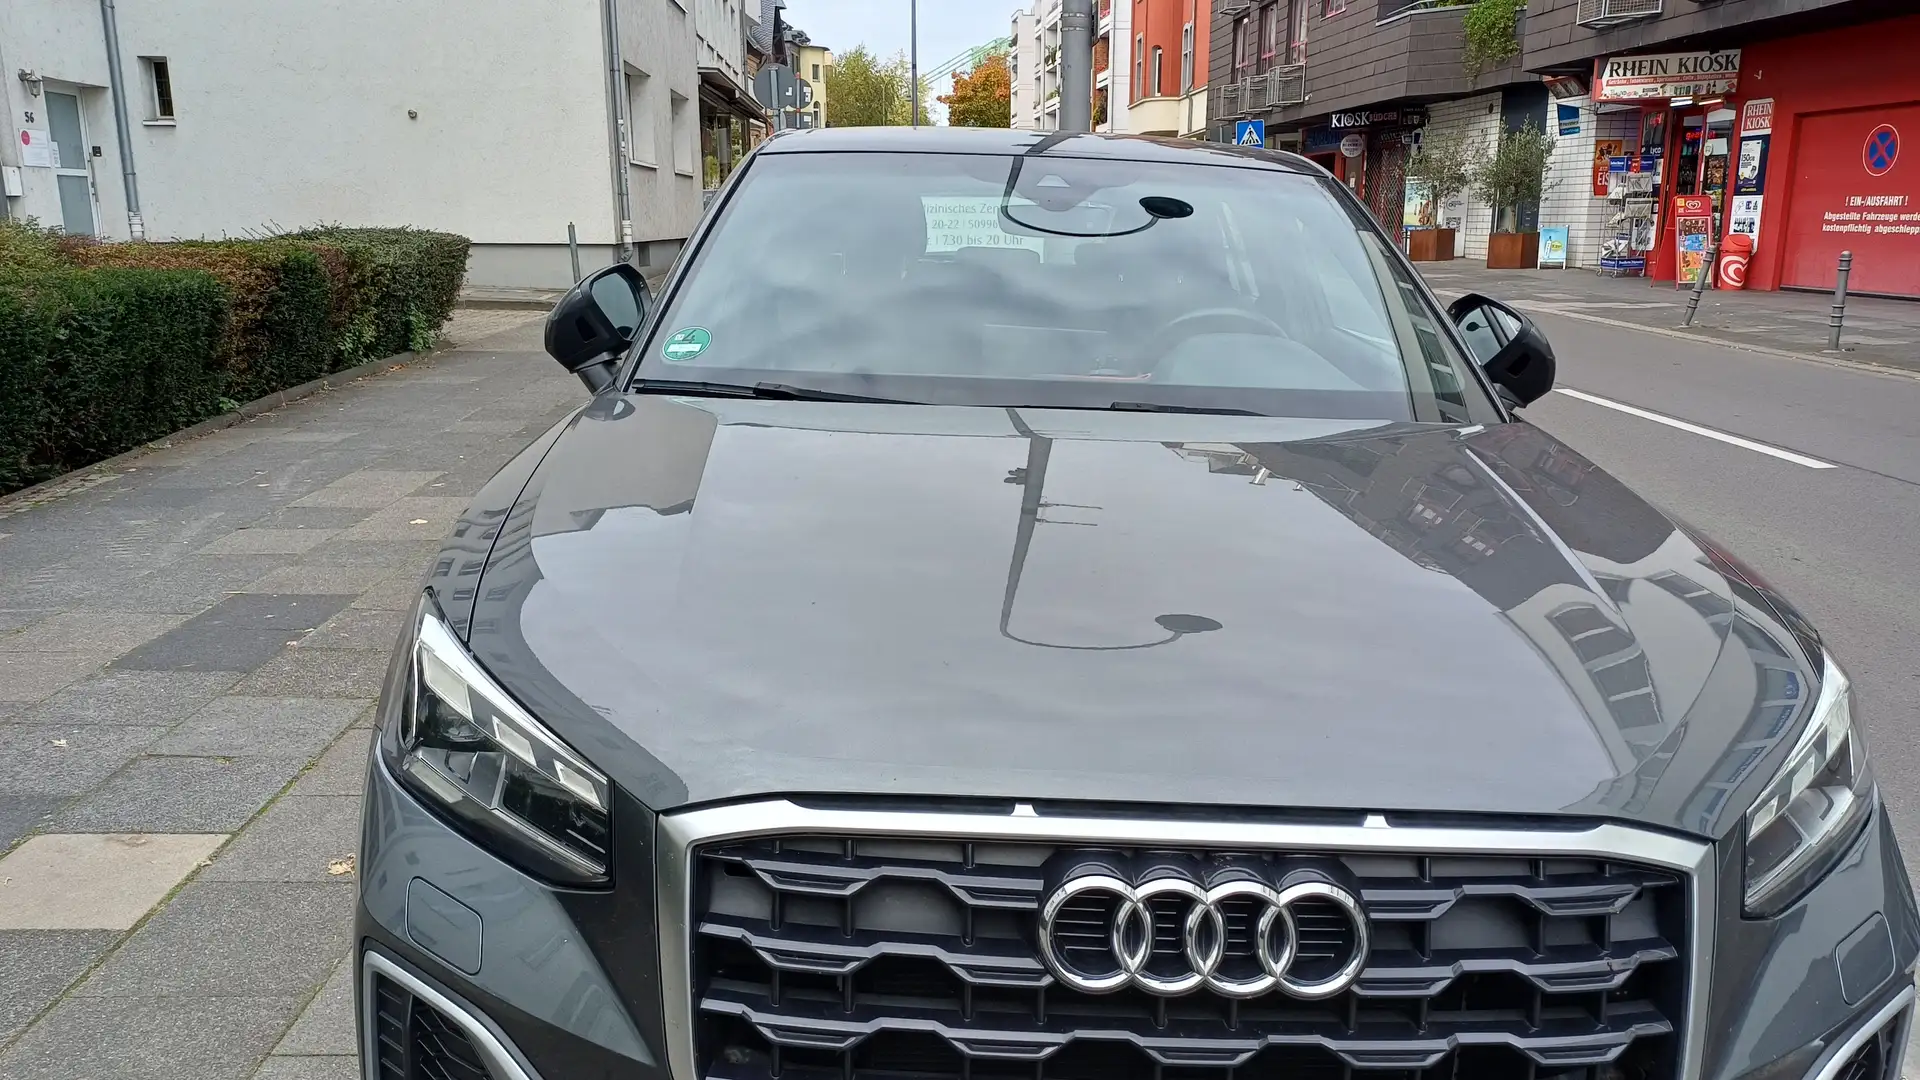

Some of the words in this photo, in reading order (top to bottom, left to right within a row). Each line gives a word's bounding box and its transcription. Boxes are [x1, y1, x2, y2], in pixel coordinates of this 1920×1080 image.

[1609, 58, 1669, 78] RHEIN
[1677, 53, 1738, 74] KIOSK
[1747, 102, 1773, 117] RHEIN
[24, 111, 35, 123] 56
[1331, 111, 1370, 128] KIOSK
[1746, 116, 1770, 130] KIOSK
[1850, 196, 1904, 206] EIN-/AUSFAHRT
[925, 203, 976, 214] izinisches
[1824, 211, 1861, 222] Abgestellte
[1862, 212, 1898, 222] Fahrzeuge
[932, 219, 959, 229] 20-22
[968, 219, 998, 229] 50996
[1822, 223, 1872, 234] kostenpflichtig
[967, 234, 982, 246] bis
[986, 234, 1000, 246] 20
[1004, 234, 1024, 246] Uhr
[682, 329, 696, 344] 4
